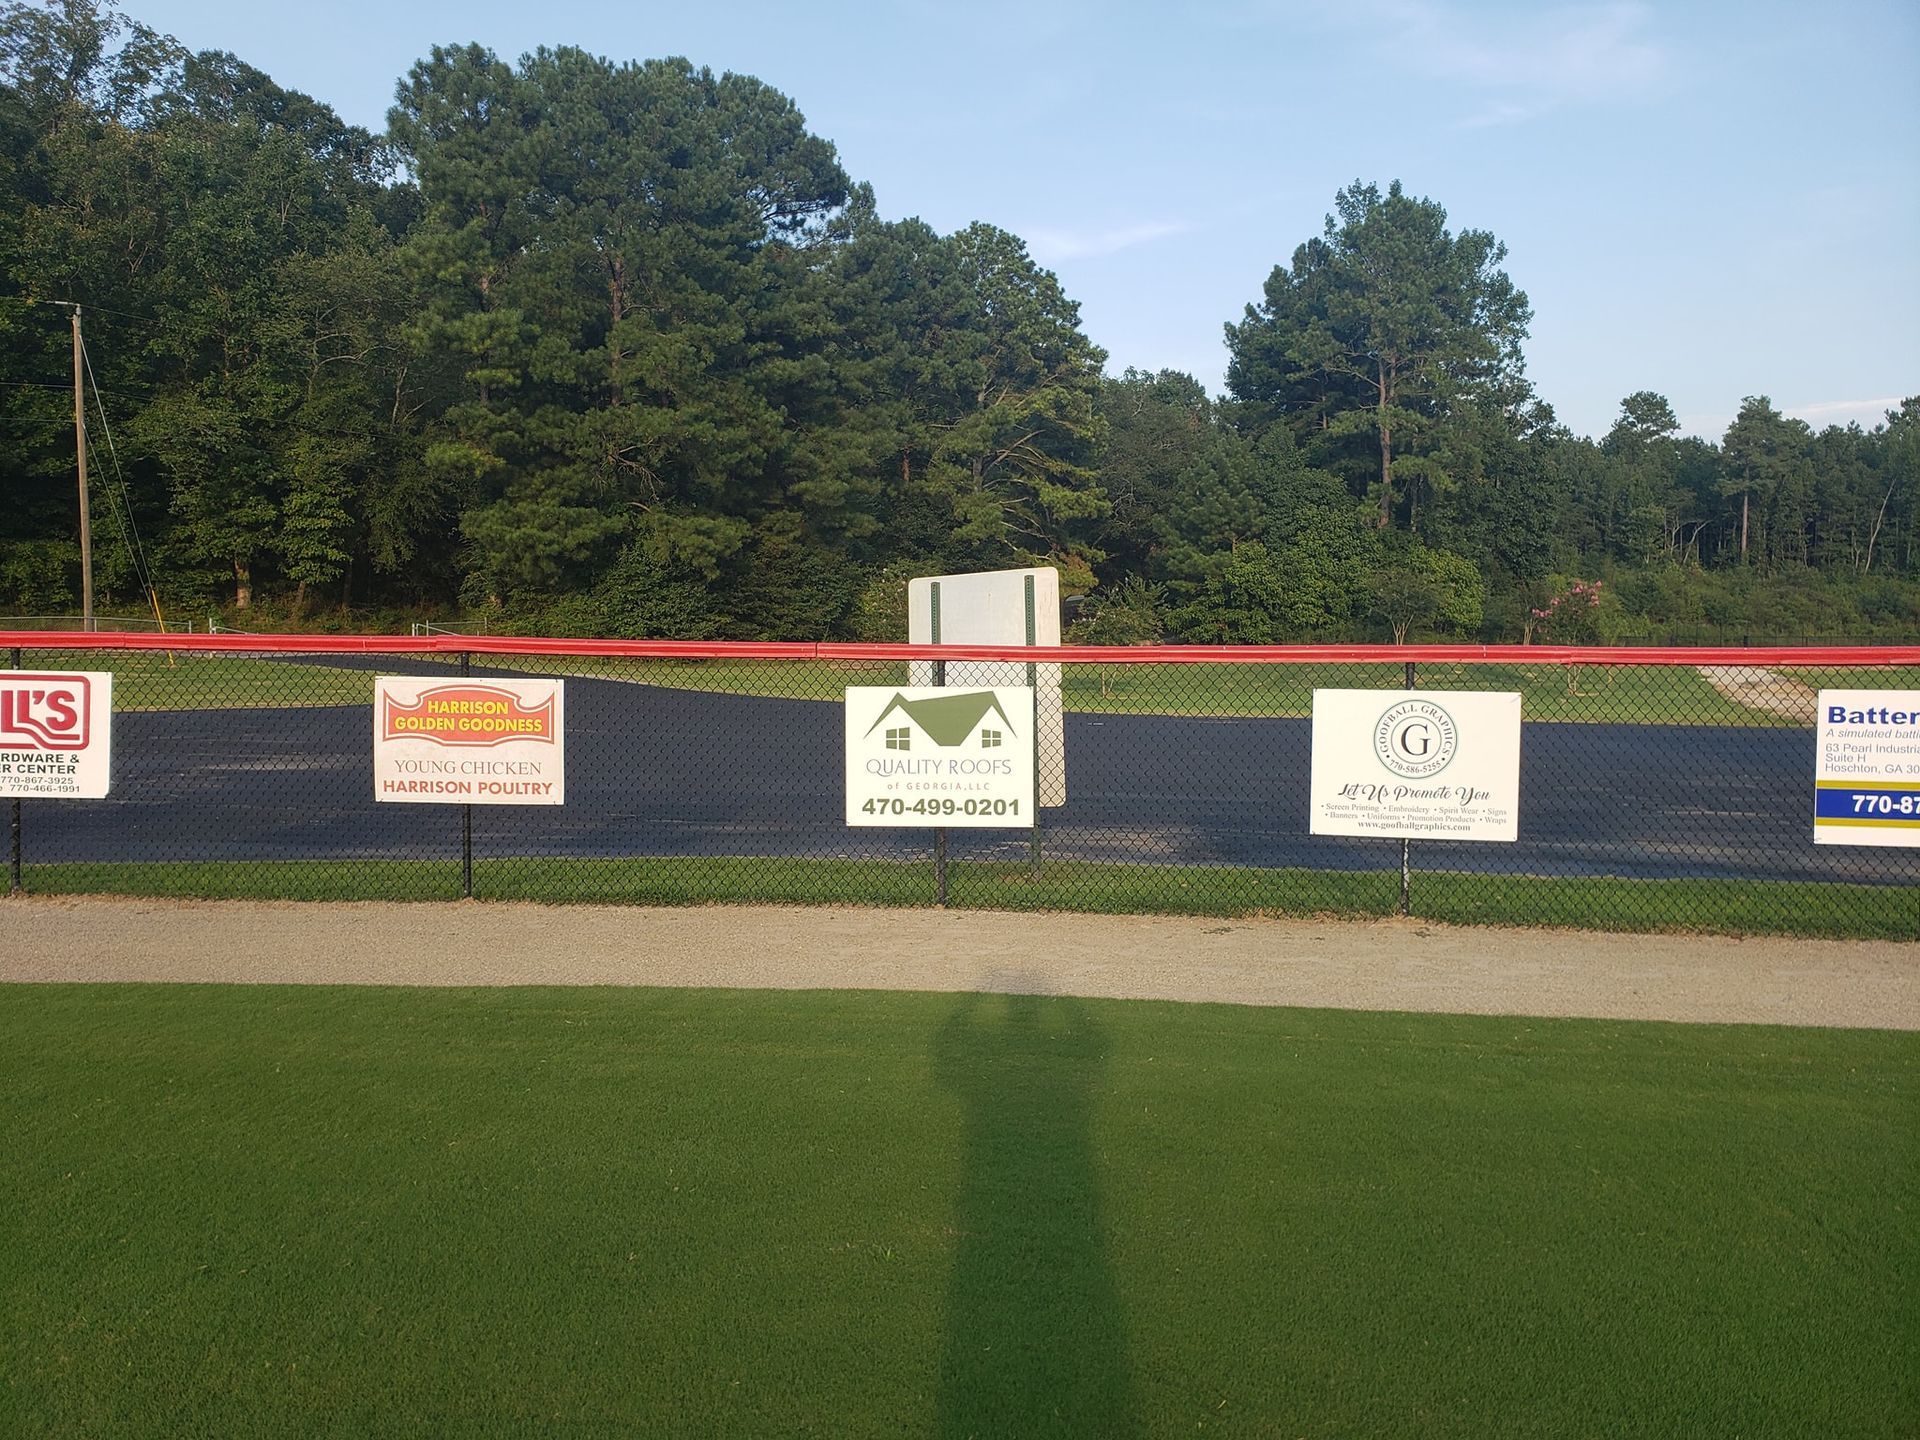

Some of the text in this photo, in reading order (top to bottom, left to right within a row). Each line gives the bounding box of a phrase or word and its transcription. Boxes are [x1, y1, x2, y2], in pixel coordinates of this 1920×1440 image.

[427, 700, 509, 715] HARRISON
[1828, 706, 1920, 725] Batter
[394, 716, 543, 732] GOLDEN GOODNESS
[1379, 704, 1453, 756] GOOFBALL GRAPHICS
[1401, 723, 1431, 756] G
[1826, 729, 1834, 738] A
[1838, 729, 1892, 739] simulated
[1825, 743, 1840, 753] 63
[1843, 743, 1872, 753] Pearl
[69, 753, 80, 764] &
[1825, 753, 1866, 762] Suite H
[16, 764, 76, 774] CENTER
[394, 760, 542, 775] YOUNG CHICKEN
[866, 759, 1012, 778] QUALITY ROOFS
[1390, 760, 1441, 773] 770-586-5255
[1825, 763, 1881, 773] Hoschton,
[1885, 764, 1903, 774] GA
[1, 776, 74, 785] 770-867-3925
[383, 780, 553, 795] HARRISON POULTRY
[887, 782, 991, 791] of GEORGIA,LLC
[10, 784, 80, 793] 770-466-1991
[1338, 783, 1491, 806] Let Us Promote You
[862, 798, 1019, 816] 470-499-0201
[1326, 803, 1507, 817] Screen Printing Embroidery Spirit Wear Signs
[1330, 811, 1507, 825] Banners Uniforms Promotion Products Wraps
[1358, 821, 1471, 832] www.goofballgraphics.com
